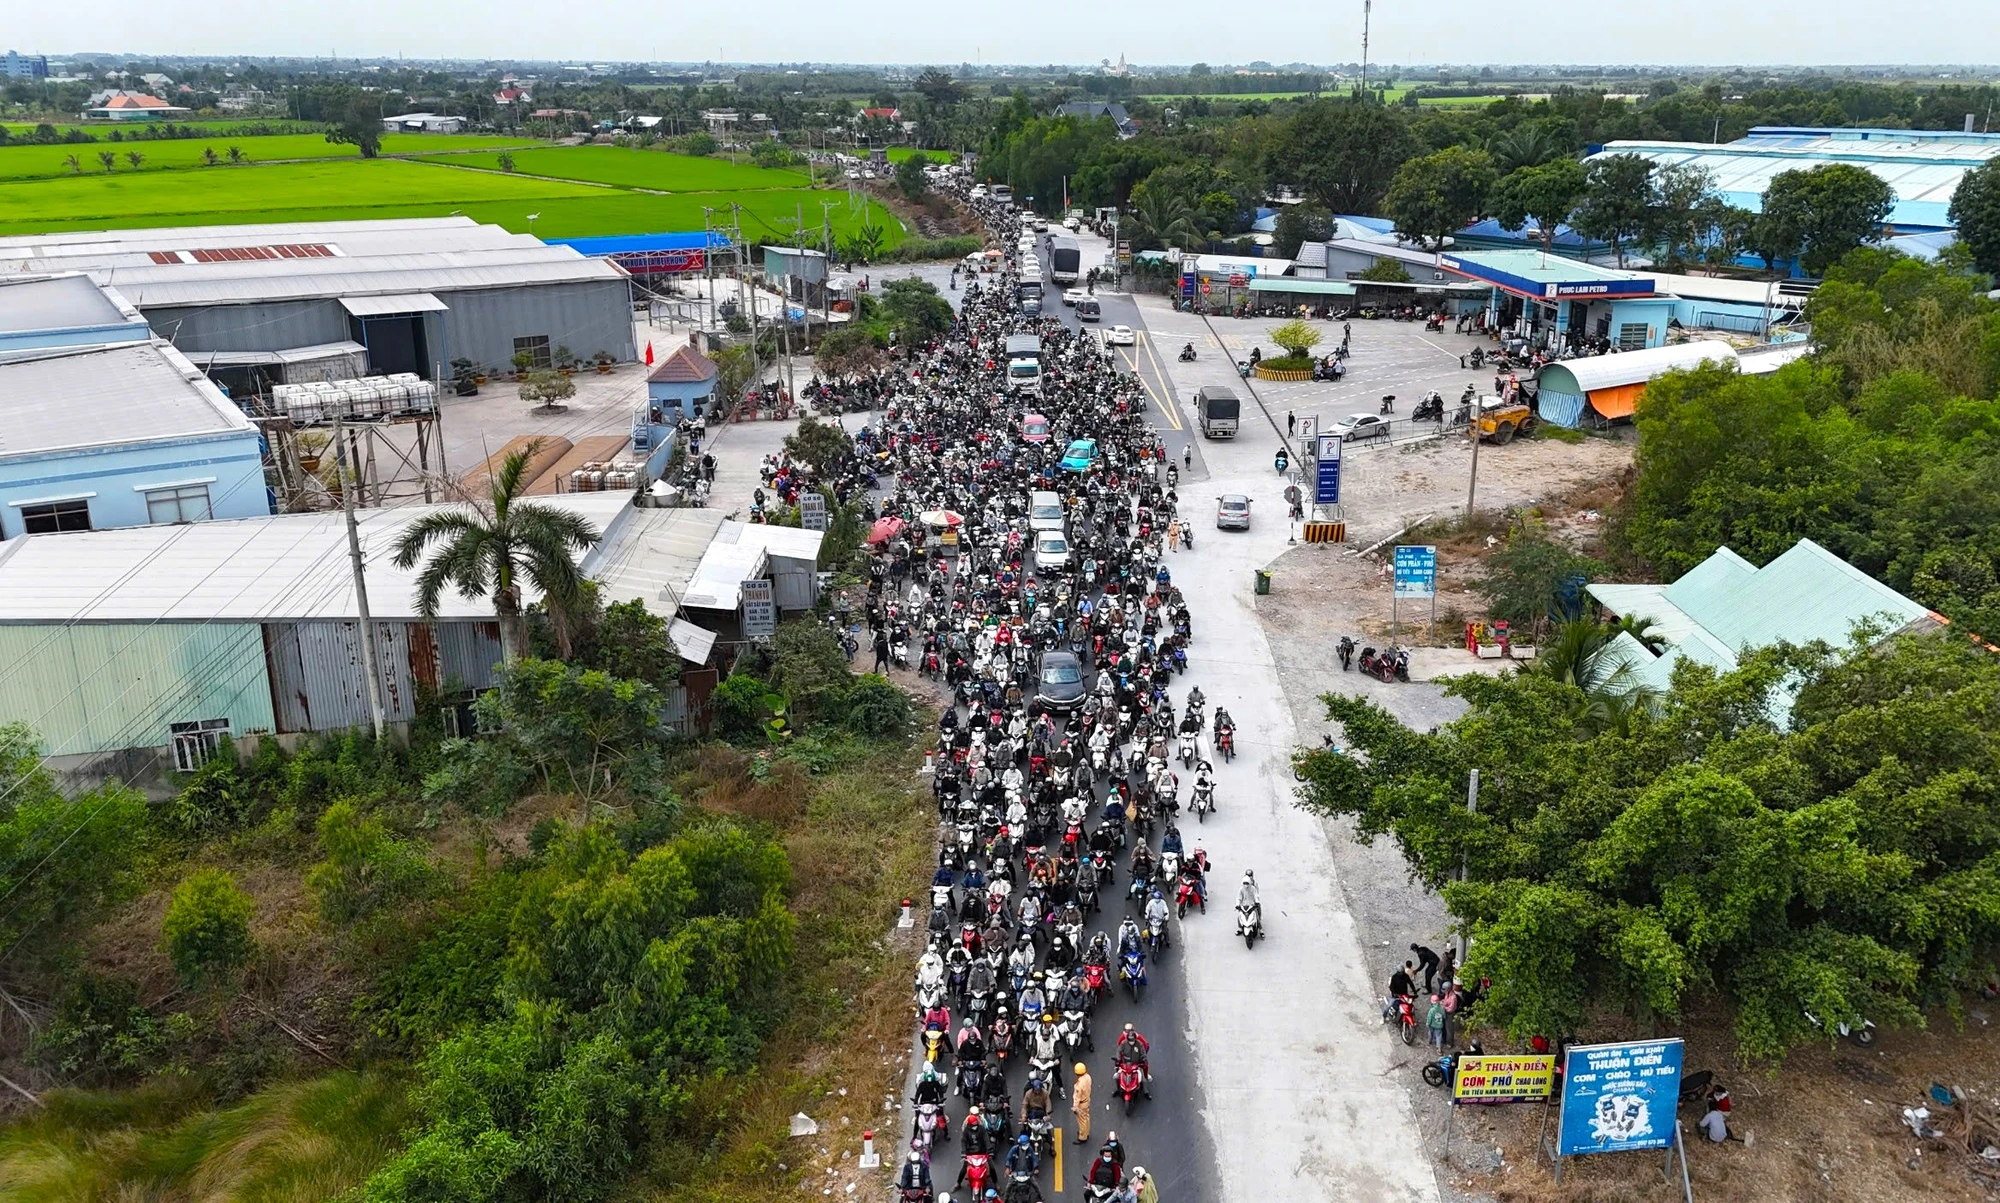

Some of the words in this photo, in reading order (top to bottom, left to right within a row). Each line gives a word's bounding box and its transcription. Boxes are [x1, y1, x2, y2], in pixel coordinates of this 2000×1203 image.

[1587, 1050, 1609, 1060] QUÁN
[1589, 1058, 1630, 1071] THUẬN
[1462, 1075, 1486, 1086] CƠM
[1492, 1074, 1513, 1086] PHỞ
[1573, 1073, 1596, 1083] CƠM
